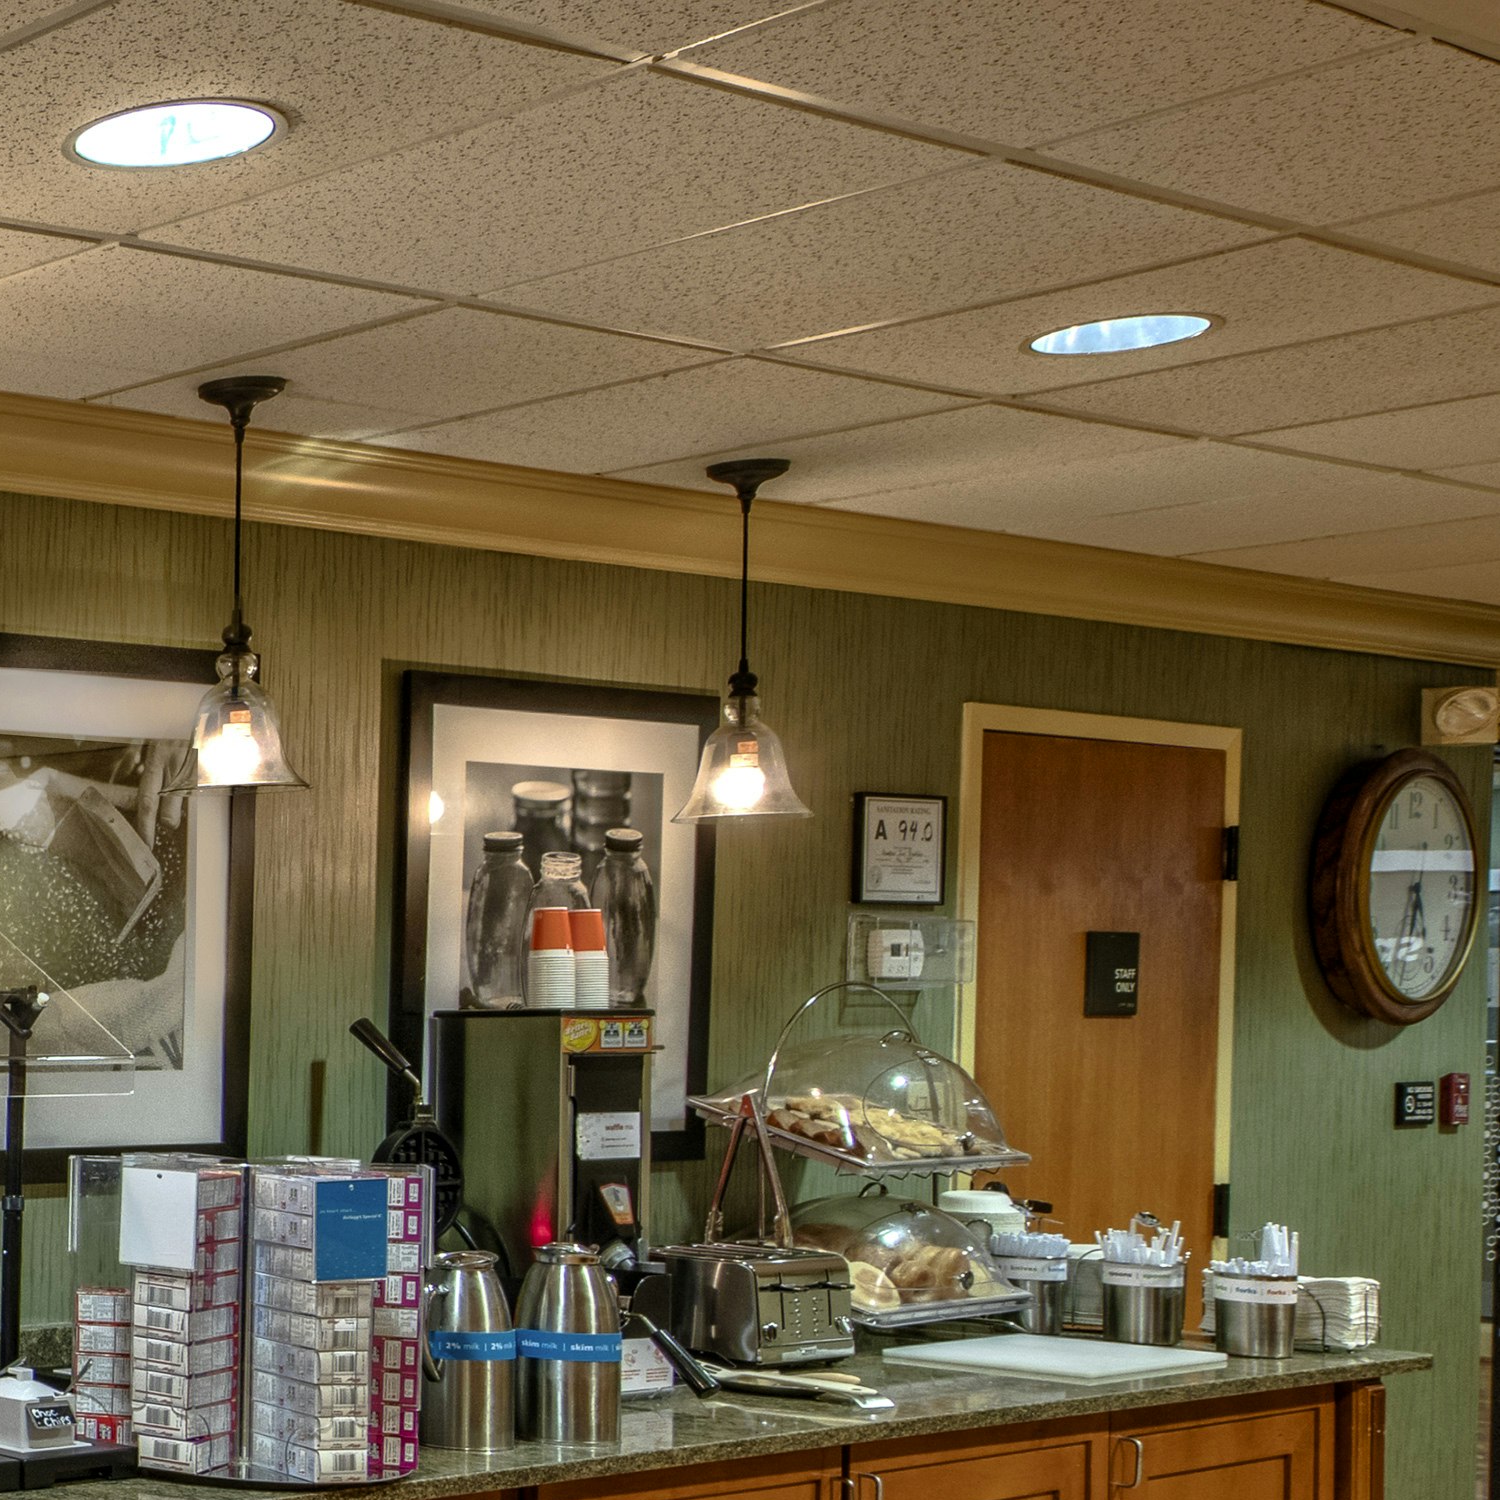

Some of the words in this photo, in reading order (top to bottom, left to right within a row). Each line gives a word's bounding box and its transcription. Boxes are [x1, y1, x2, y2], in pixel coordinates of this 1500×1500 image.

[874, 819, 887, 840] A
[1115, 968, 1136, 979] STAFF
[1116, 982, 1135, 992] ONLY
[490, 1342, 503, 1350] 2%
[521, 1340, 539, 1348] skim
